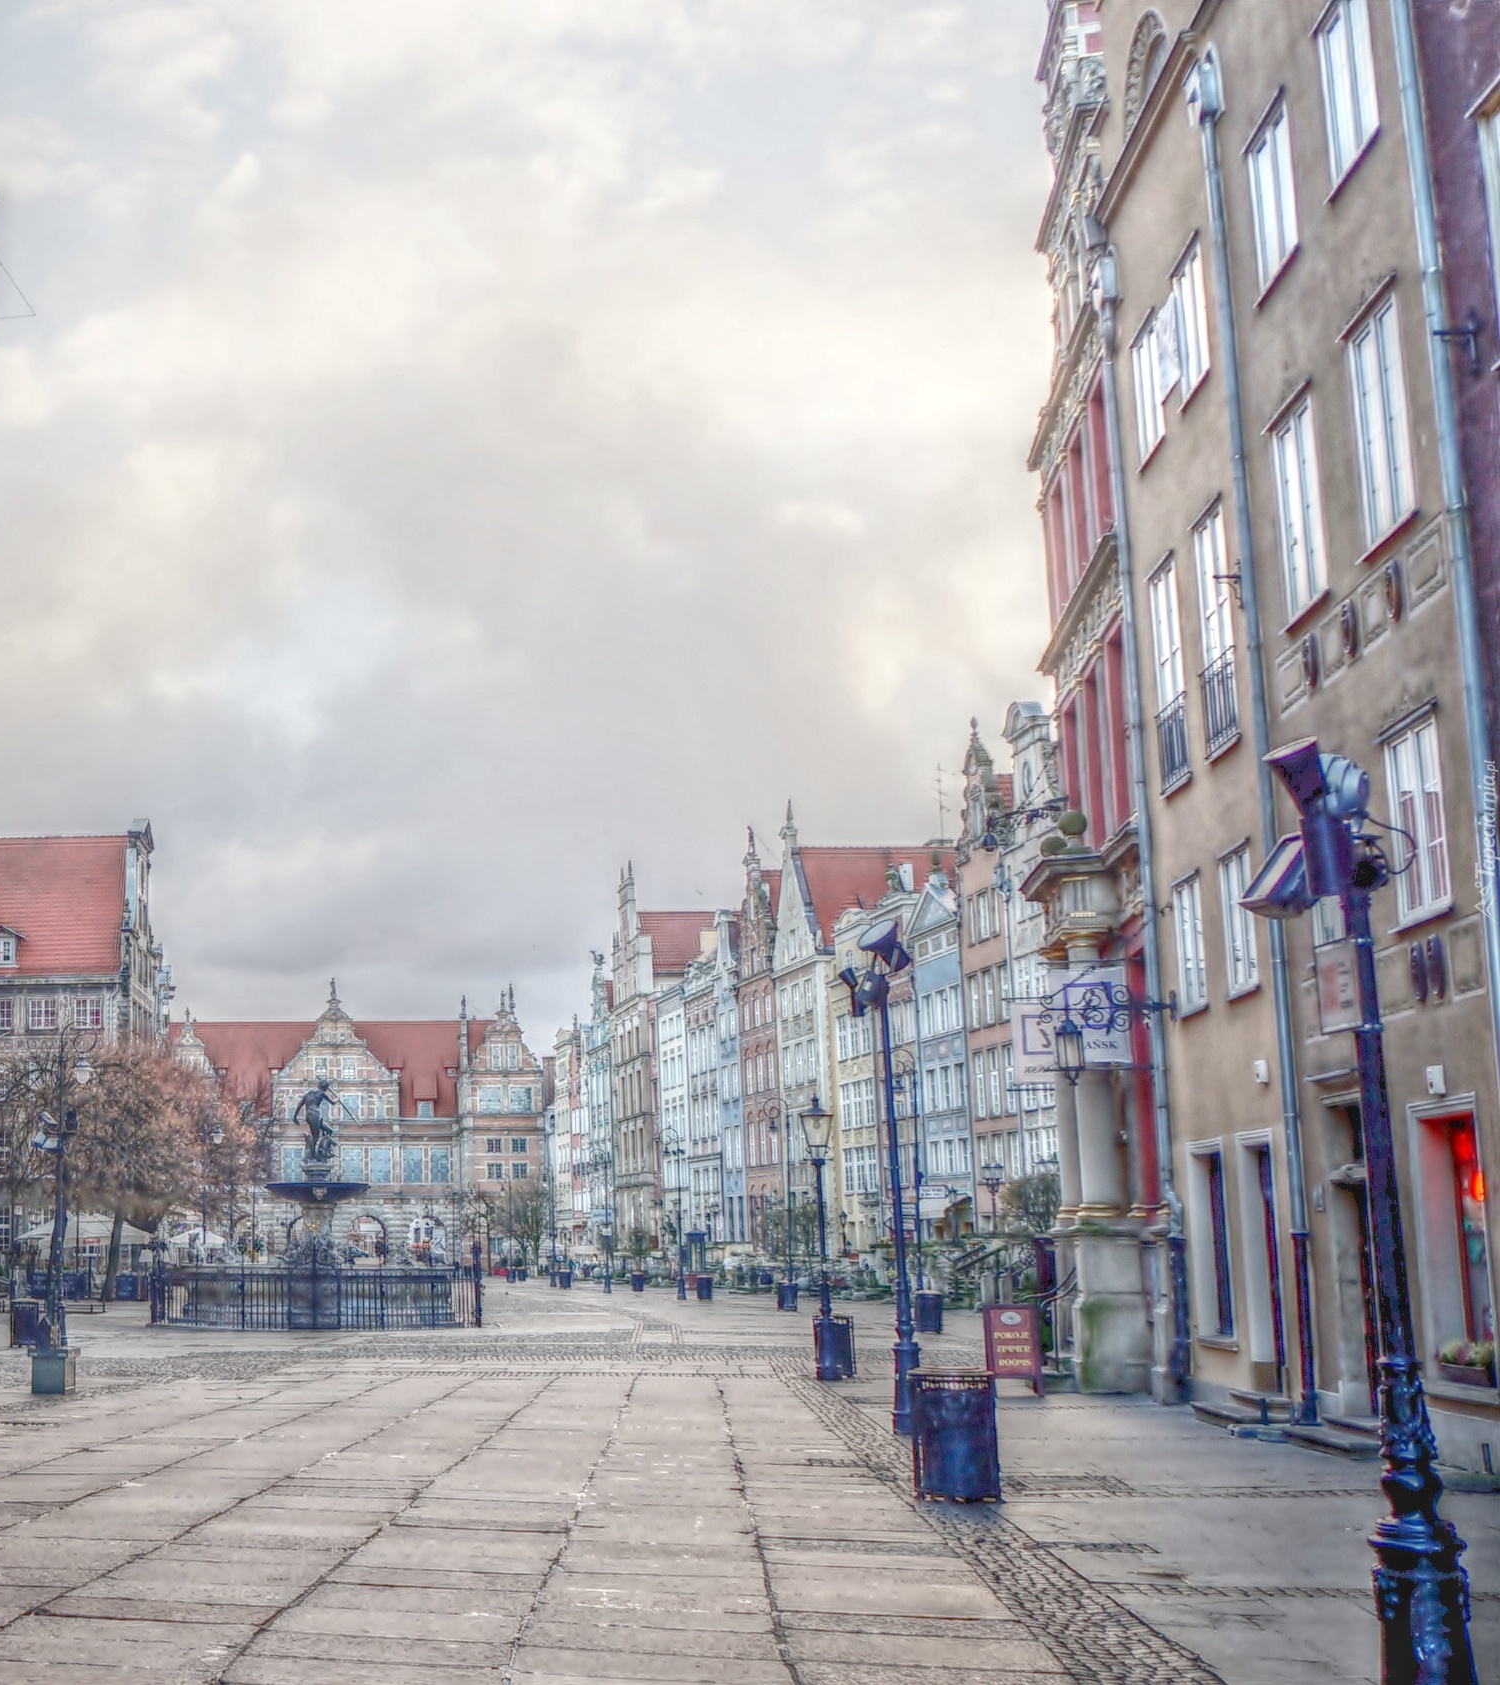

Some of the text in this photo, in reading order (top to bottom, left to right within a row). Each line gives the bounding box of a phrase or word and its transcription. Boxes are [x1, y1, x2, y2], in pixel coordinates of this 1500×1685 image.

[1084, 1038, 1118, 1050] AŃSK
[993, 1331, 1030, 1340] POKOJE
[996, 1344, 1031, 1353] ZIMMER
[998, 1358, 1032, 1367] ROOMS
